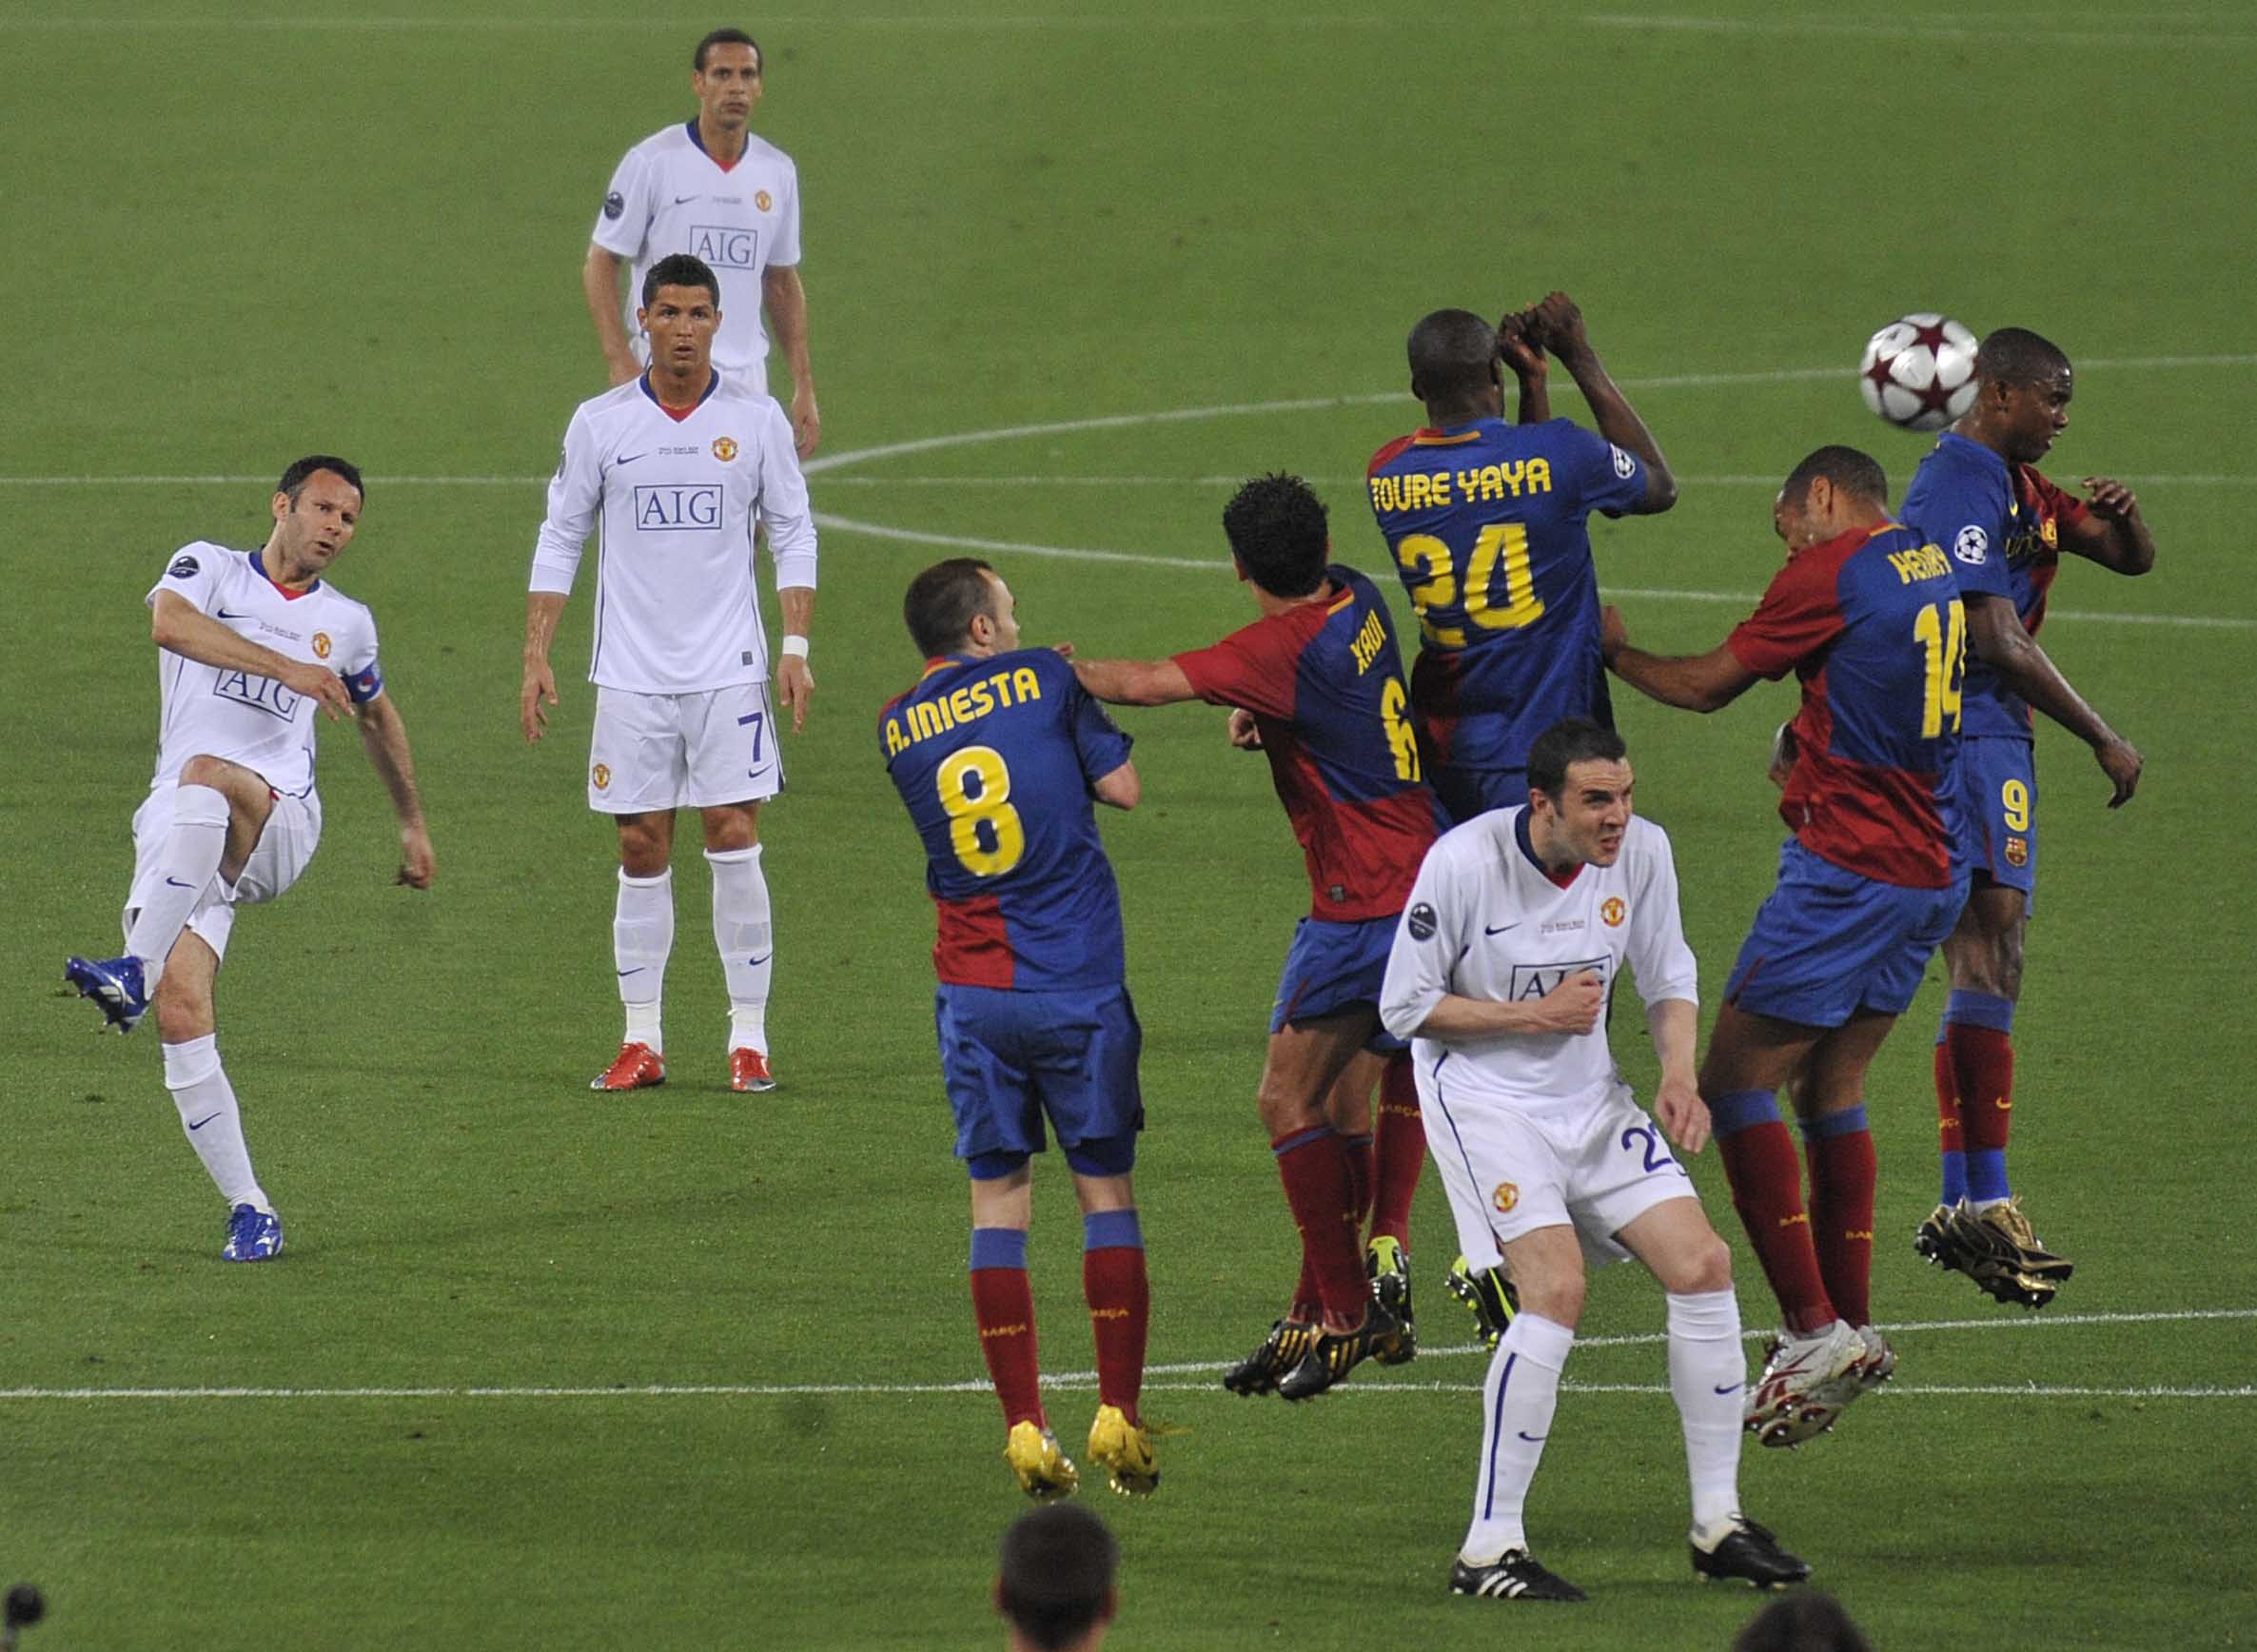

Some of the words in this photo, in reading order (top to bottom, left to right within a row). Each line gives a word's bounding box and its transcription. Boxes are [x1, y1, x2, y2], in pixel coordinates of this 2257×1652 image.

[697, 232, 752, 266] AIG
[641, 489, 718, 524] AIG
[1370, 472, 1451, 512] TOURE
[1457, 457, 1553, 503] YAYA
[1398, 522, 1545, 648] 24
[220, 670, 298, 716] AIG
[1914, 600, 1967, 739] 14
[737, 711, 765, 763] 7
[886, 667, 1042, 757] A.INIESTA
[1381, 677, 1422, 782] 6
[936, 745, 1025, 876] 8
[2002, 779, 2029, 832] 9
[1621, 1121, 1679, 1172] 2
